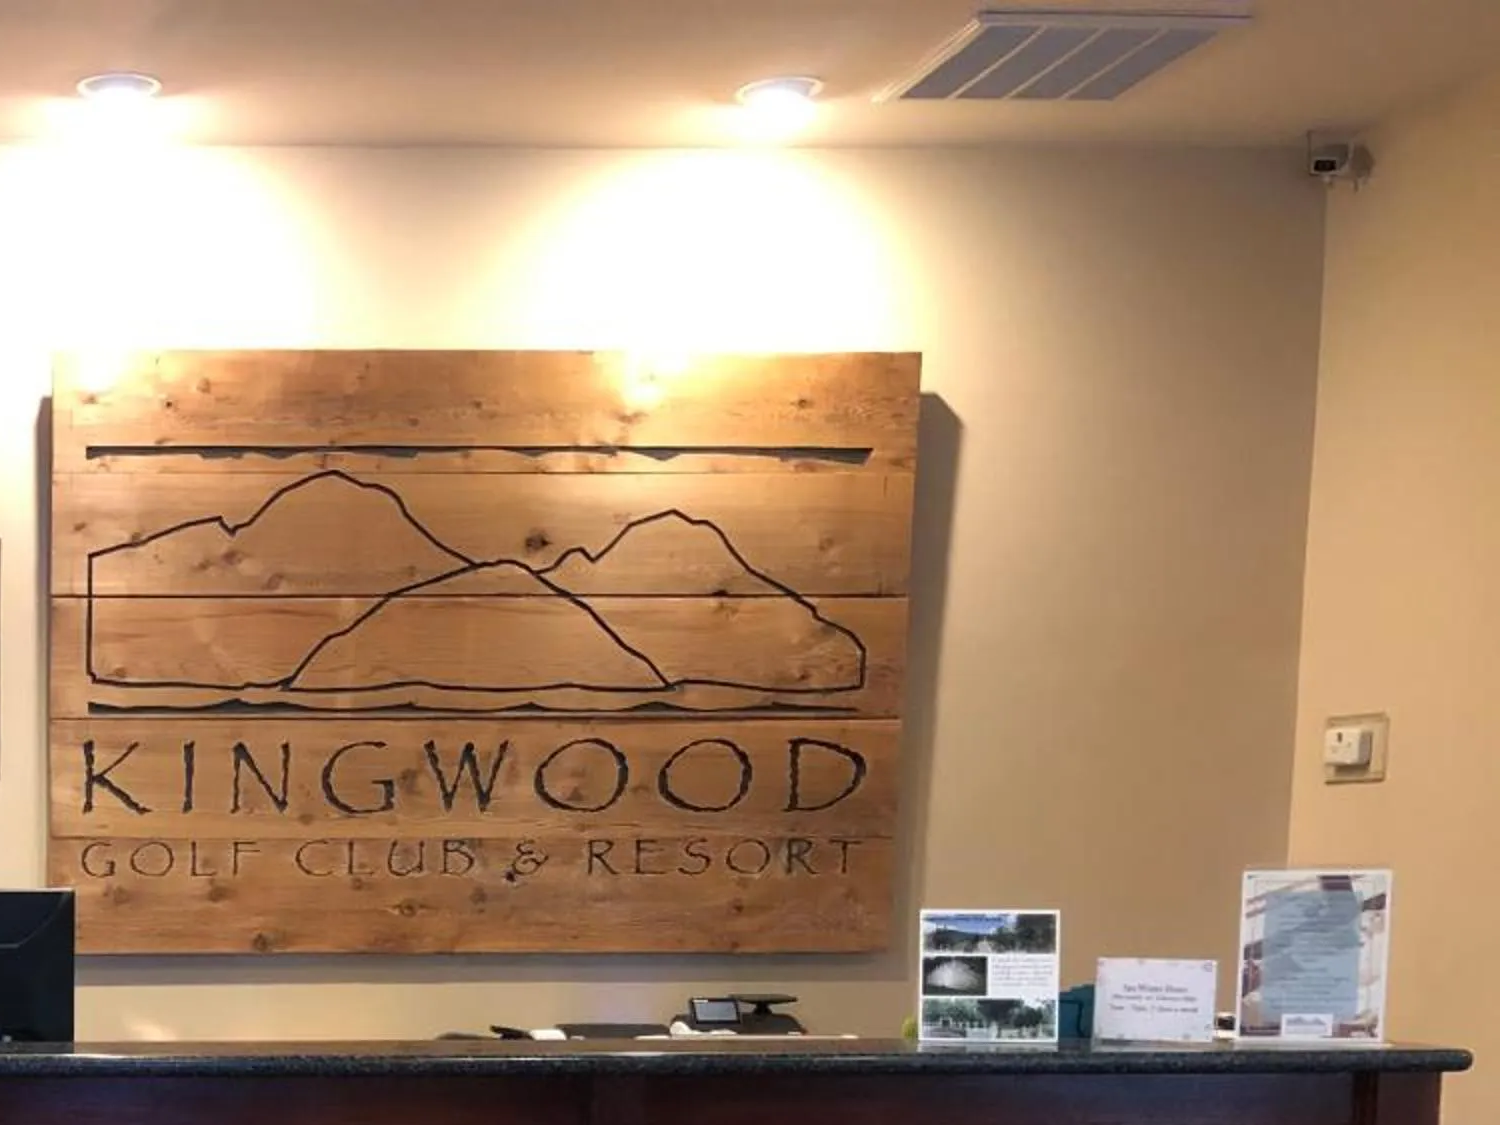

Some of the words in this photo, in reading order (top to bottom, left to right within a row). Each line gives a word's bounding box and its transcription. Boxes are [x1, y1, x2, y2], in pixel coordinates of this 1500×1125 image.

[81, 737, 867, 815] KINGWOOD
[80, 840, 261, 878] GOLF
[294, 838, 475, 878] CLUB
[511, 840, 550, 878] &
[586, 838, 864, 876] RESORT
